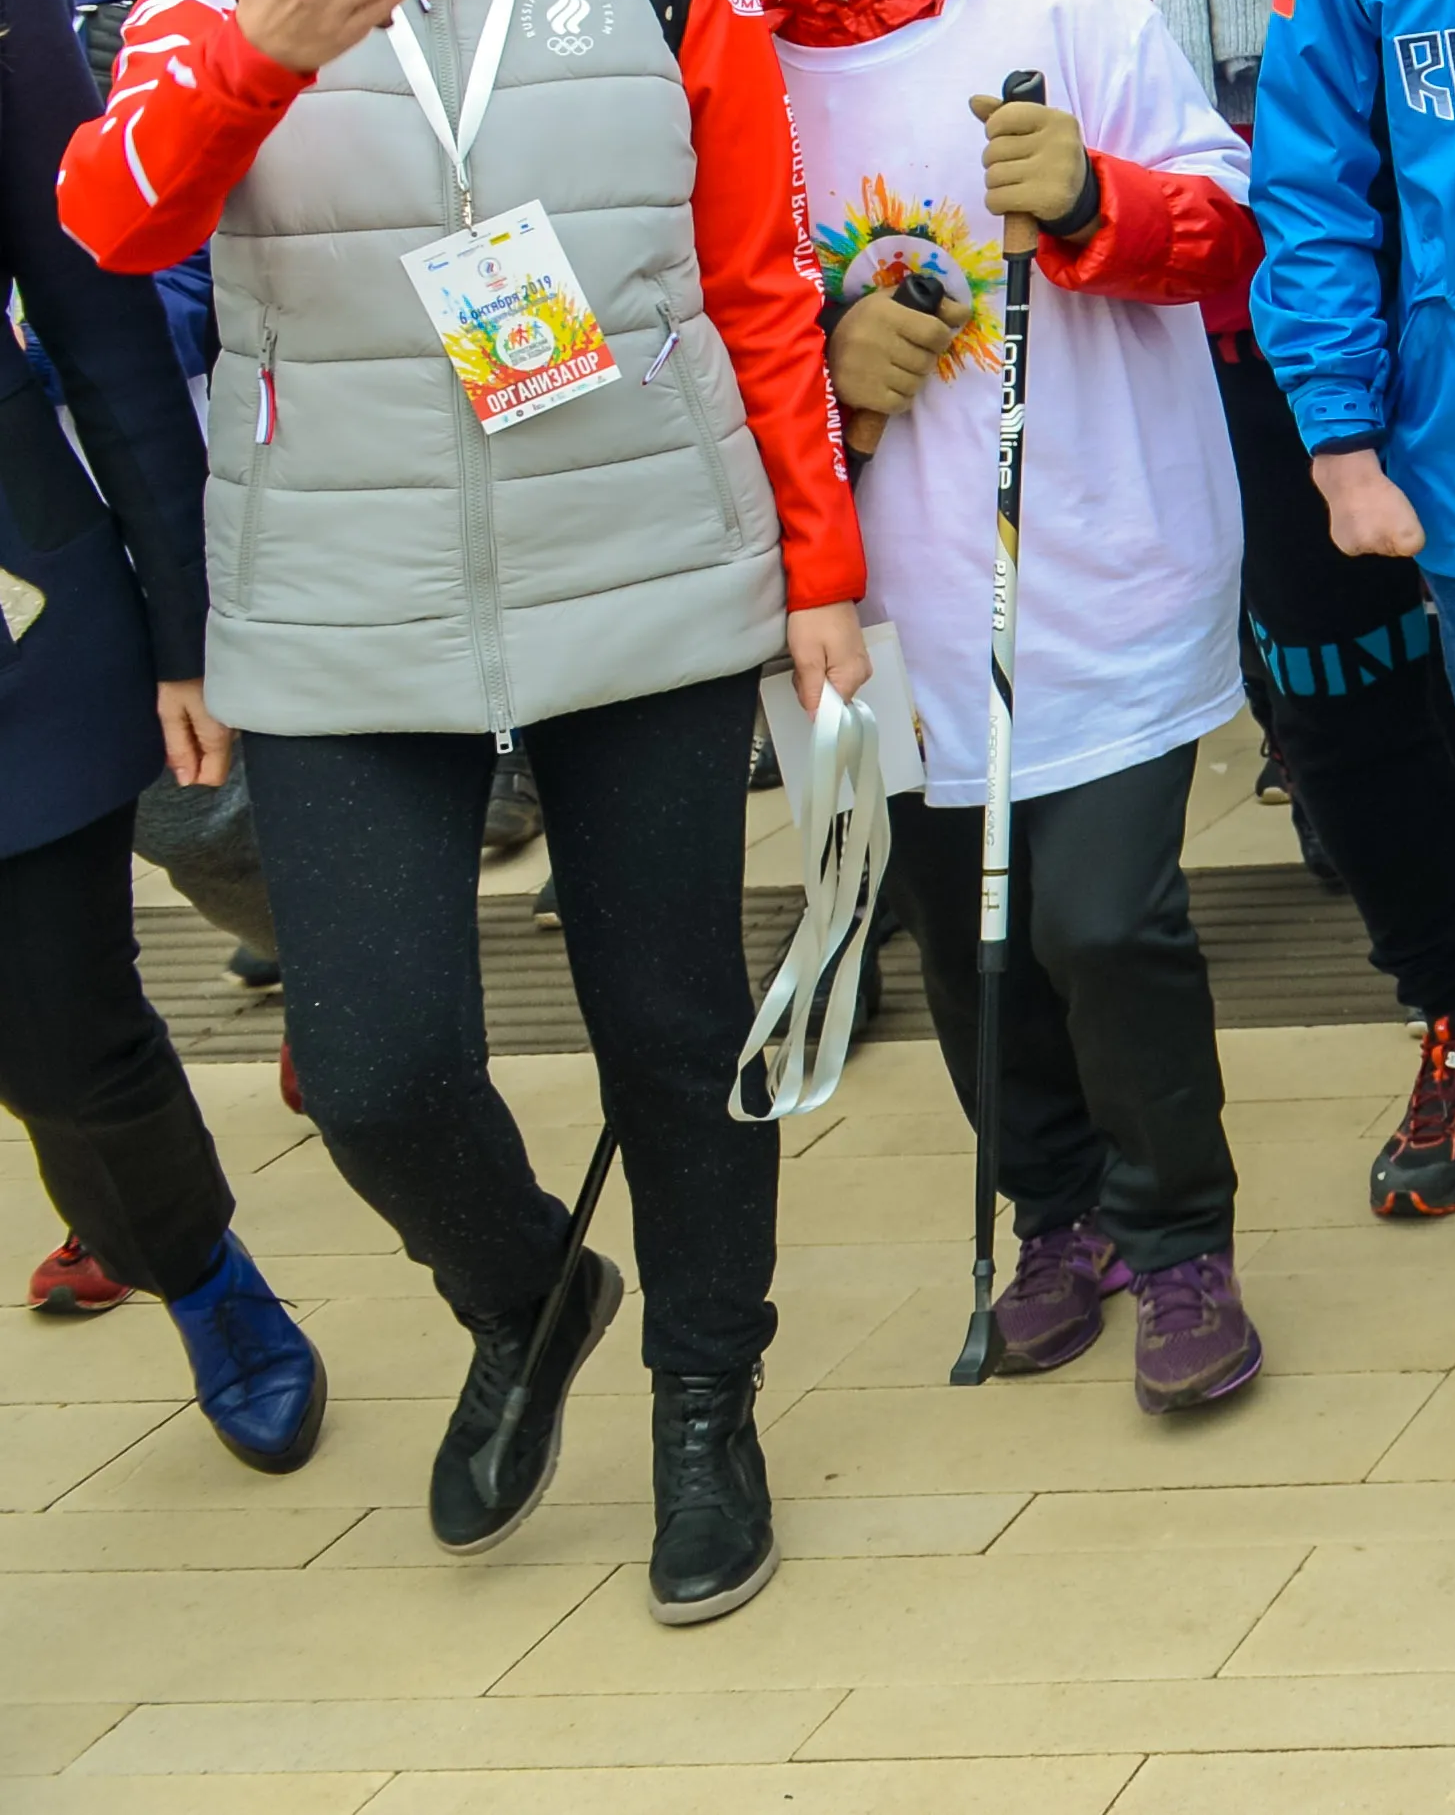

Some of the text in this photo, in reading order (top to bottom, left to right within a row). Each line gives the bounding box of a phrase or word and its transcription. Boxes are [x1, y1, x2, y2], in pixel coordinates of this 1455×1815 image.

[602, 3, 616, 35] TEAM
[460, 275, 552, 325] 6 октября 2019
[486, 352, 600, 414] ОРГАНИЗАТОР
